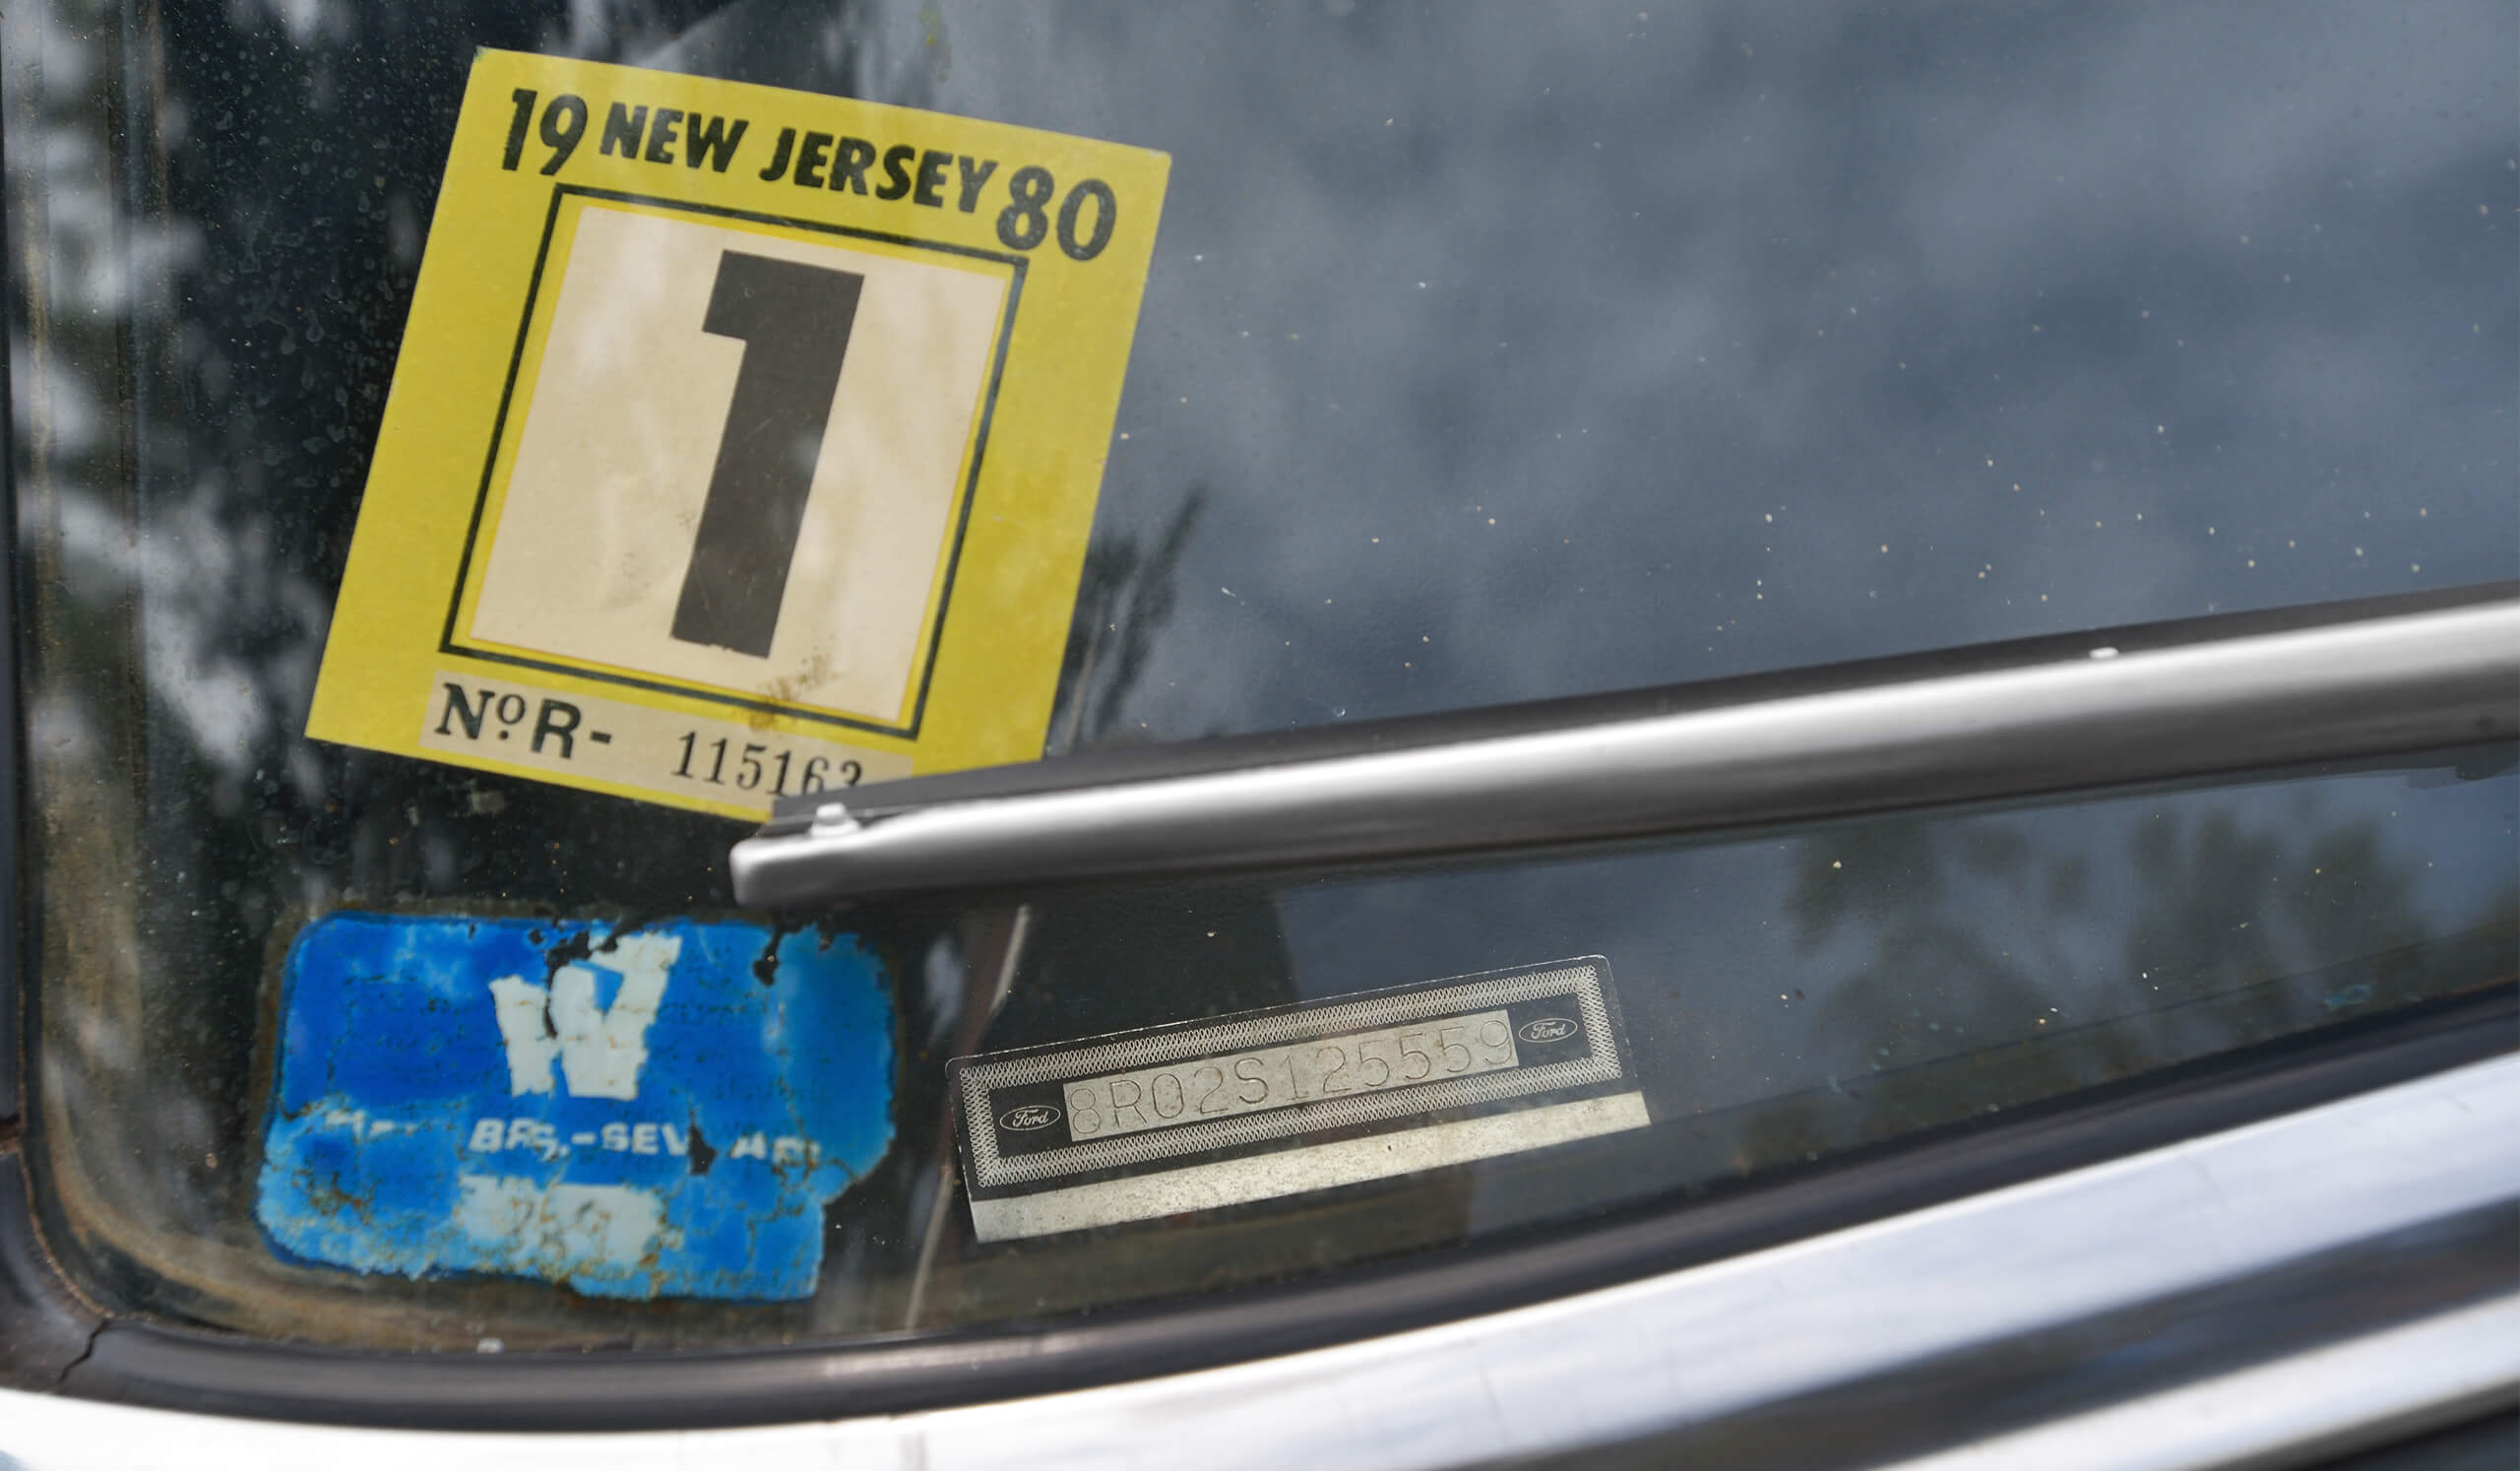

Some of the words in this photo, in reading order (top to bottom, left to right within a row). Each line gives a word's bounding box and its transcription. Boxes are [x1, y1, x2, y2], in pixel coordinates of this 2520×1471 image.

[501, 88, 589, 176] 19
[598, 100, 749, 173] NEW
[759, 126, 998, 215] JERSEY
[994, 164, 1118, 262] 80
[670, 249, 865, 660] 1
[1069, 1017, 1514, 1134] 8R02S125559
[1529, 1020, 1569, 1041] Ford
[1010, 1108, 1050, 1128] Ford
